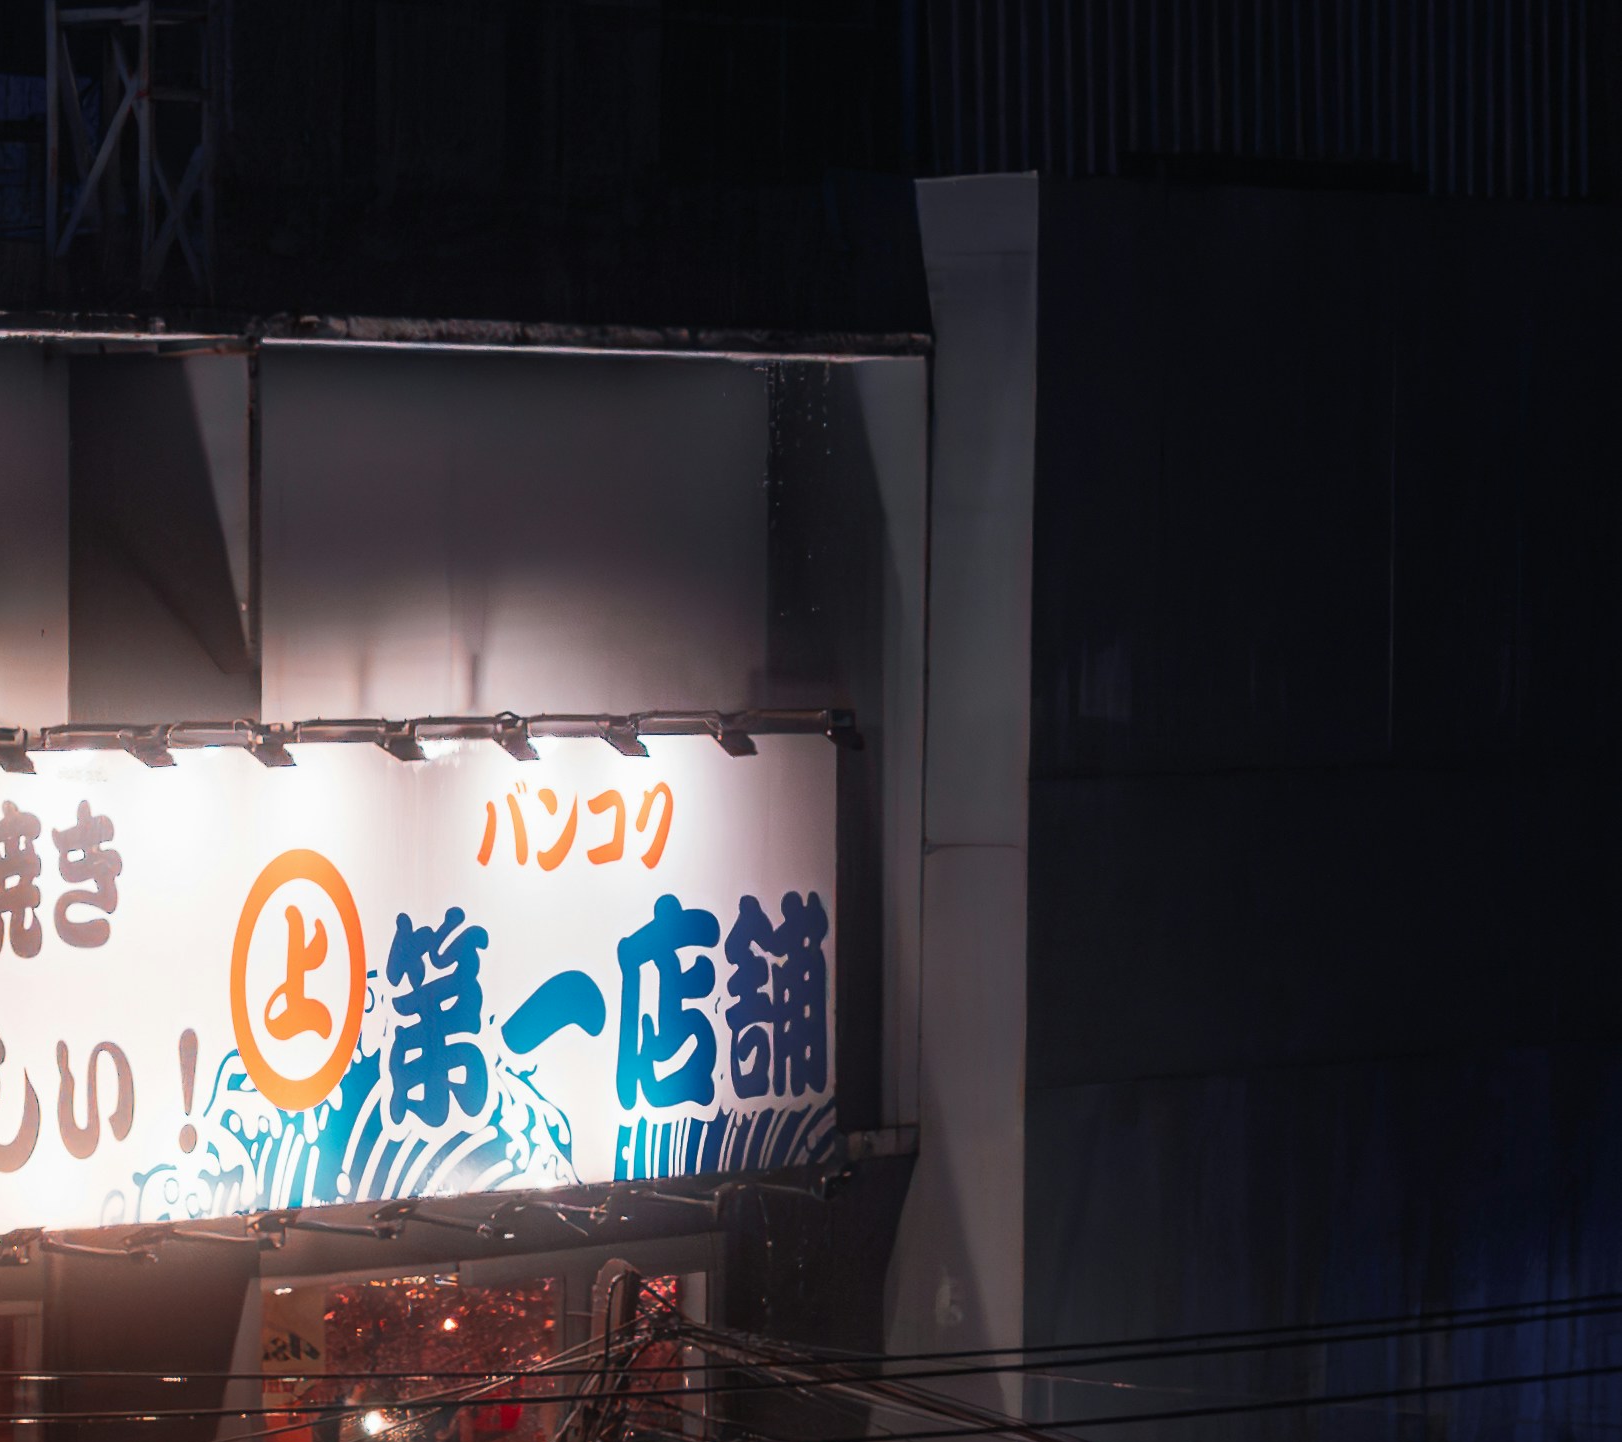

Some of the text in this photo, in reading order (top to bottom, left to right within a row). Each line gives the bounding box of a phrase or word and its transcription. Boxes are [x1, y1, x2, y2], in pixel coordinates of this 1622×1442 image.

[477, 780, 674, 872] バンコク
[386, 890, 829, 1128] 第一店舗
